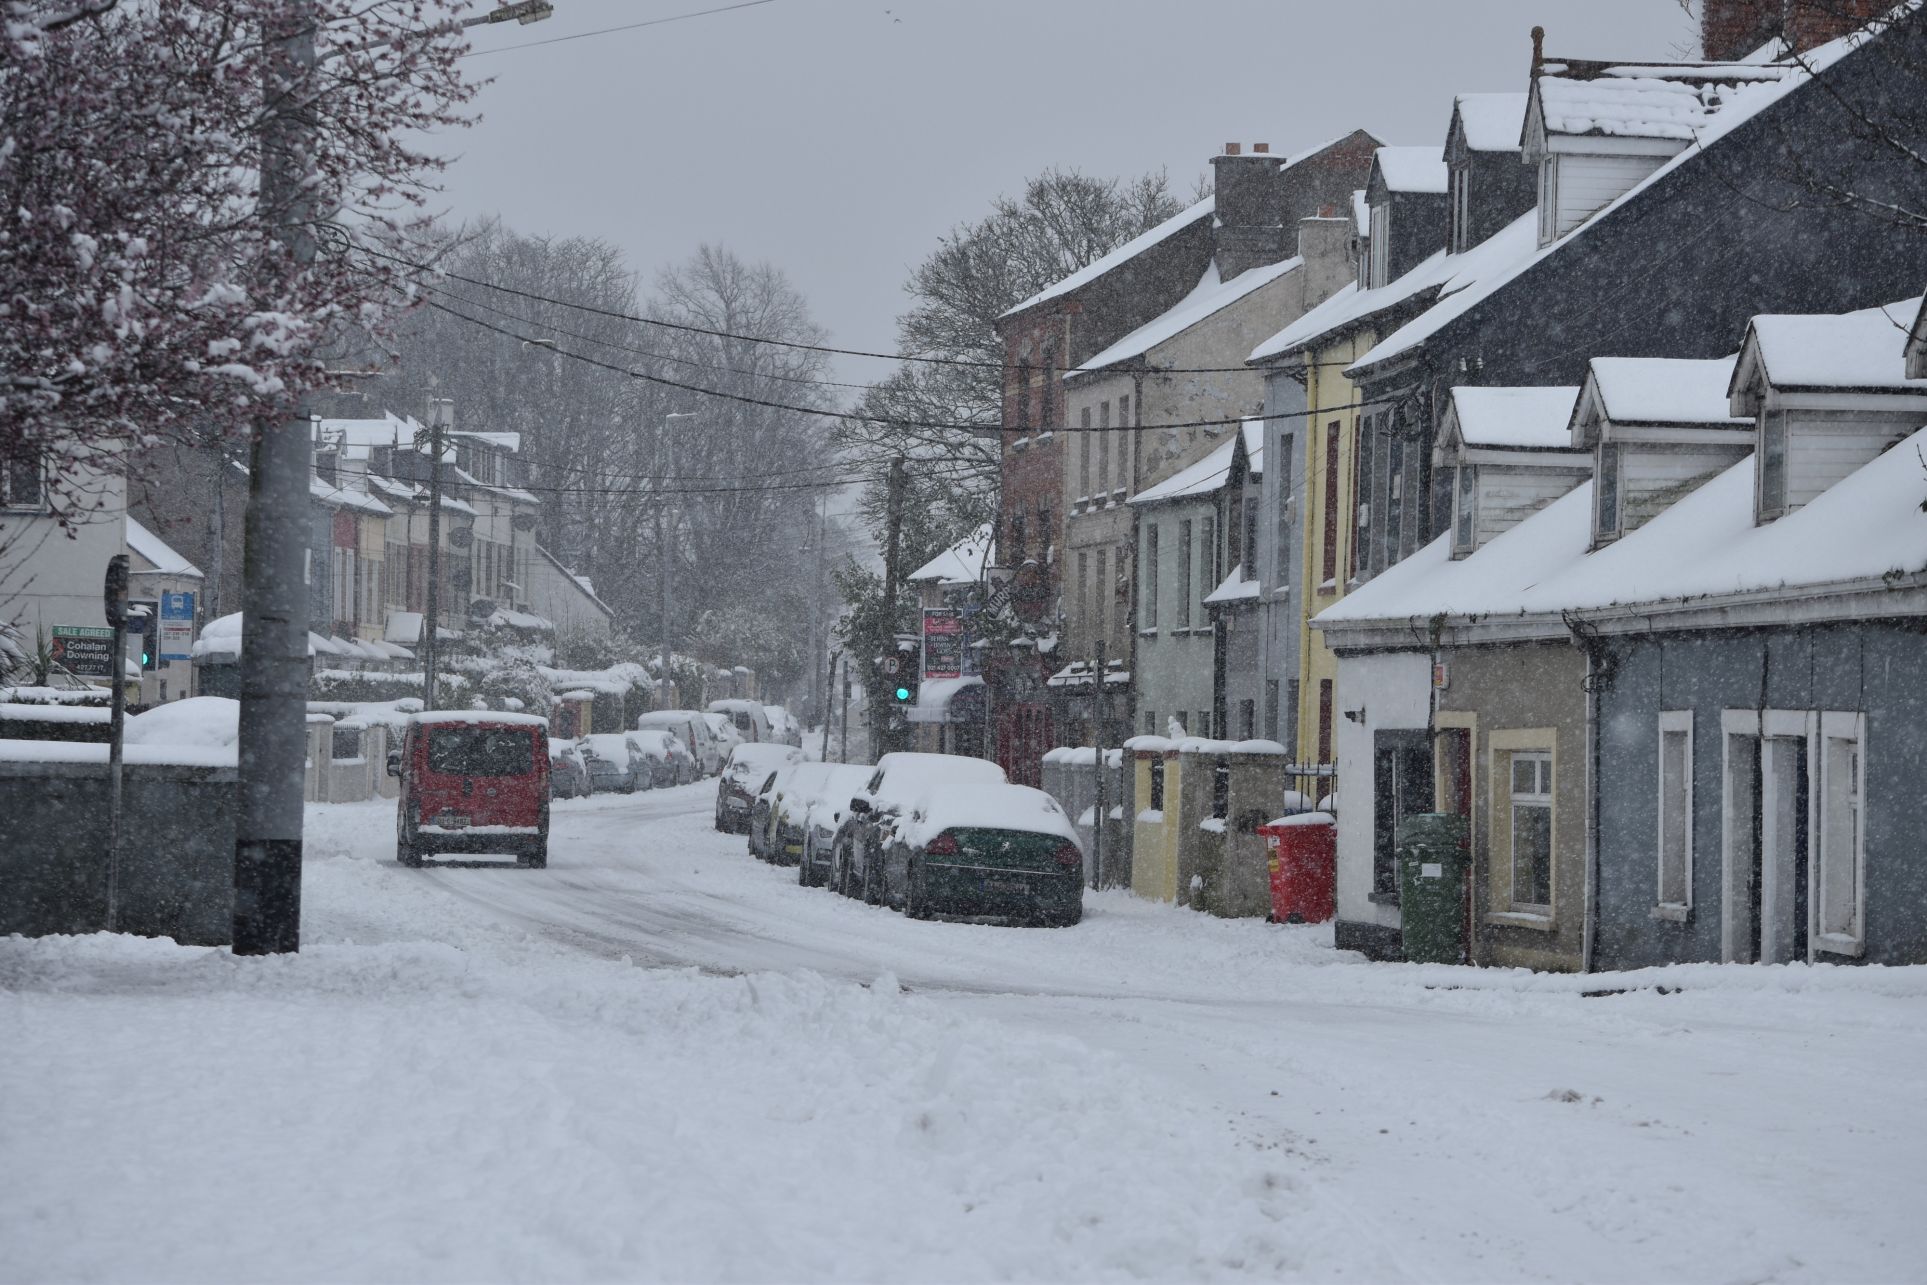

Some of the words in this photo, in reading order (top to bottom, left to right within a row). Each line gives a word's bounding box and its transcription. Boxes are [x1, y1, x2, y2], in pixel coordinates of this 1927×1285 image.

[57, 627, 79, 636] SALE
[79, 628, 111, 638] AGREED
[66, 641, 107, 651] Cohalan
[66, 650, 109, 662] Downing
